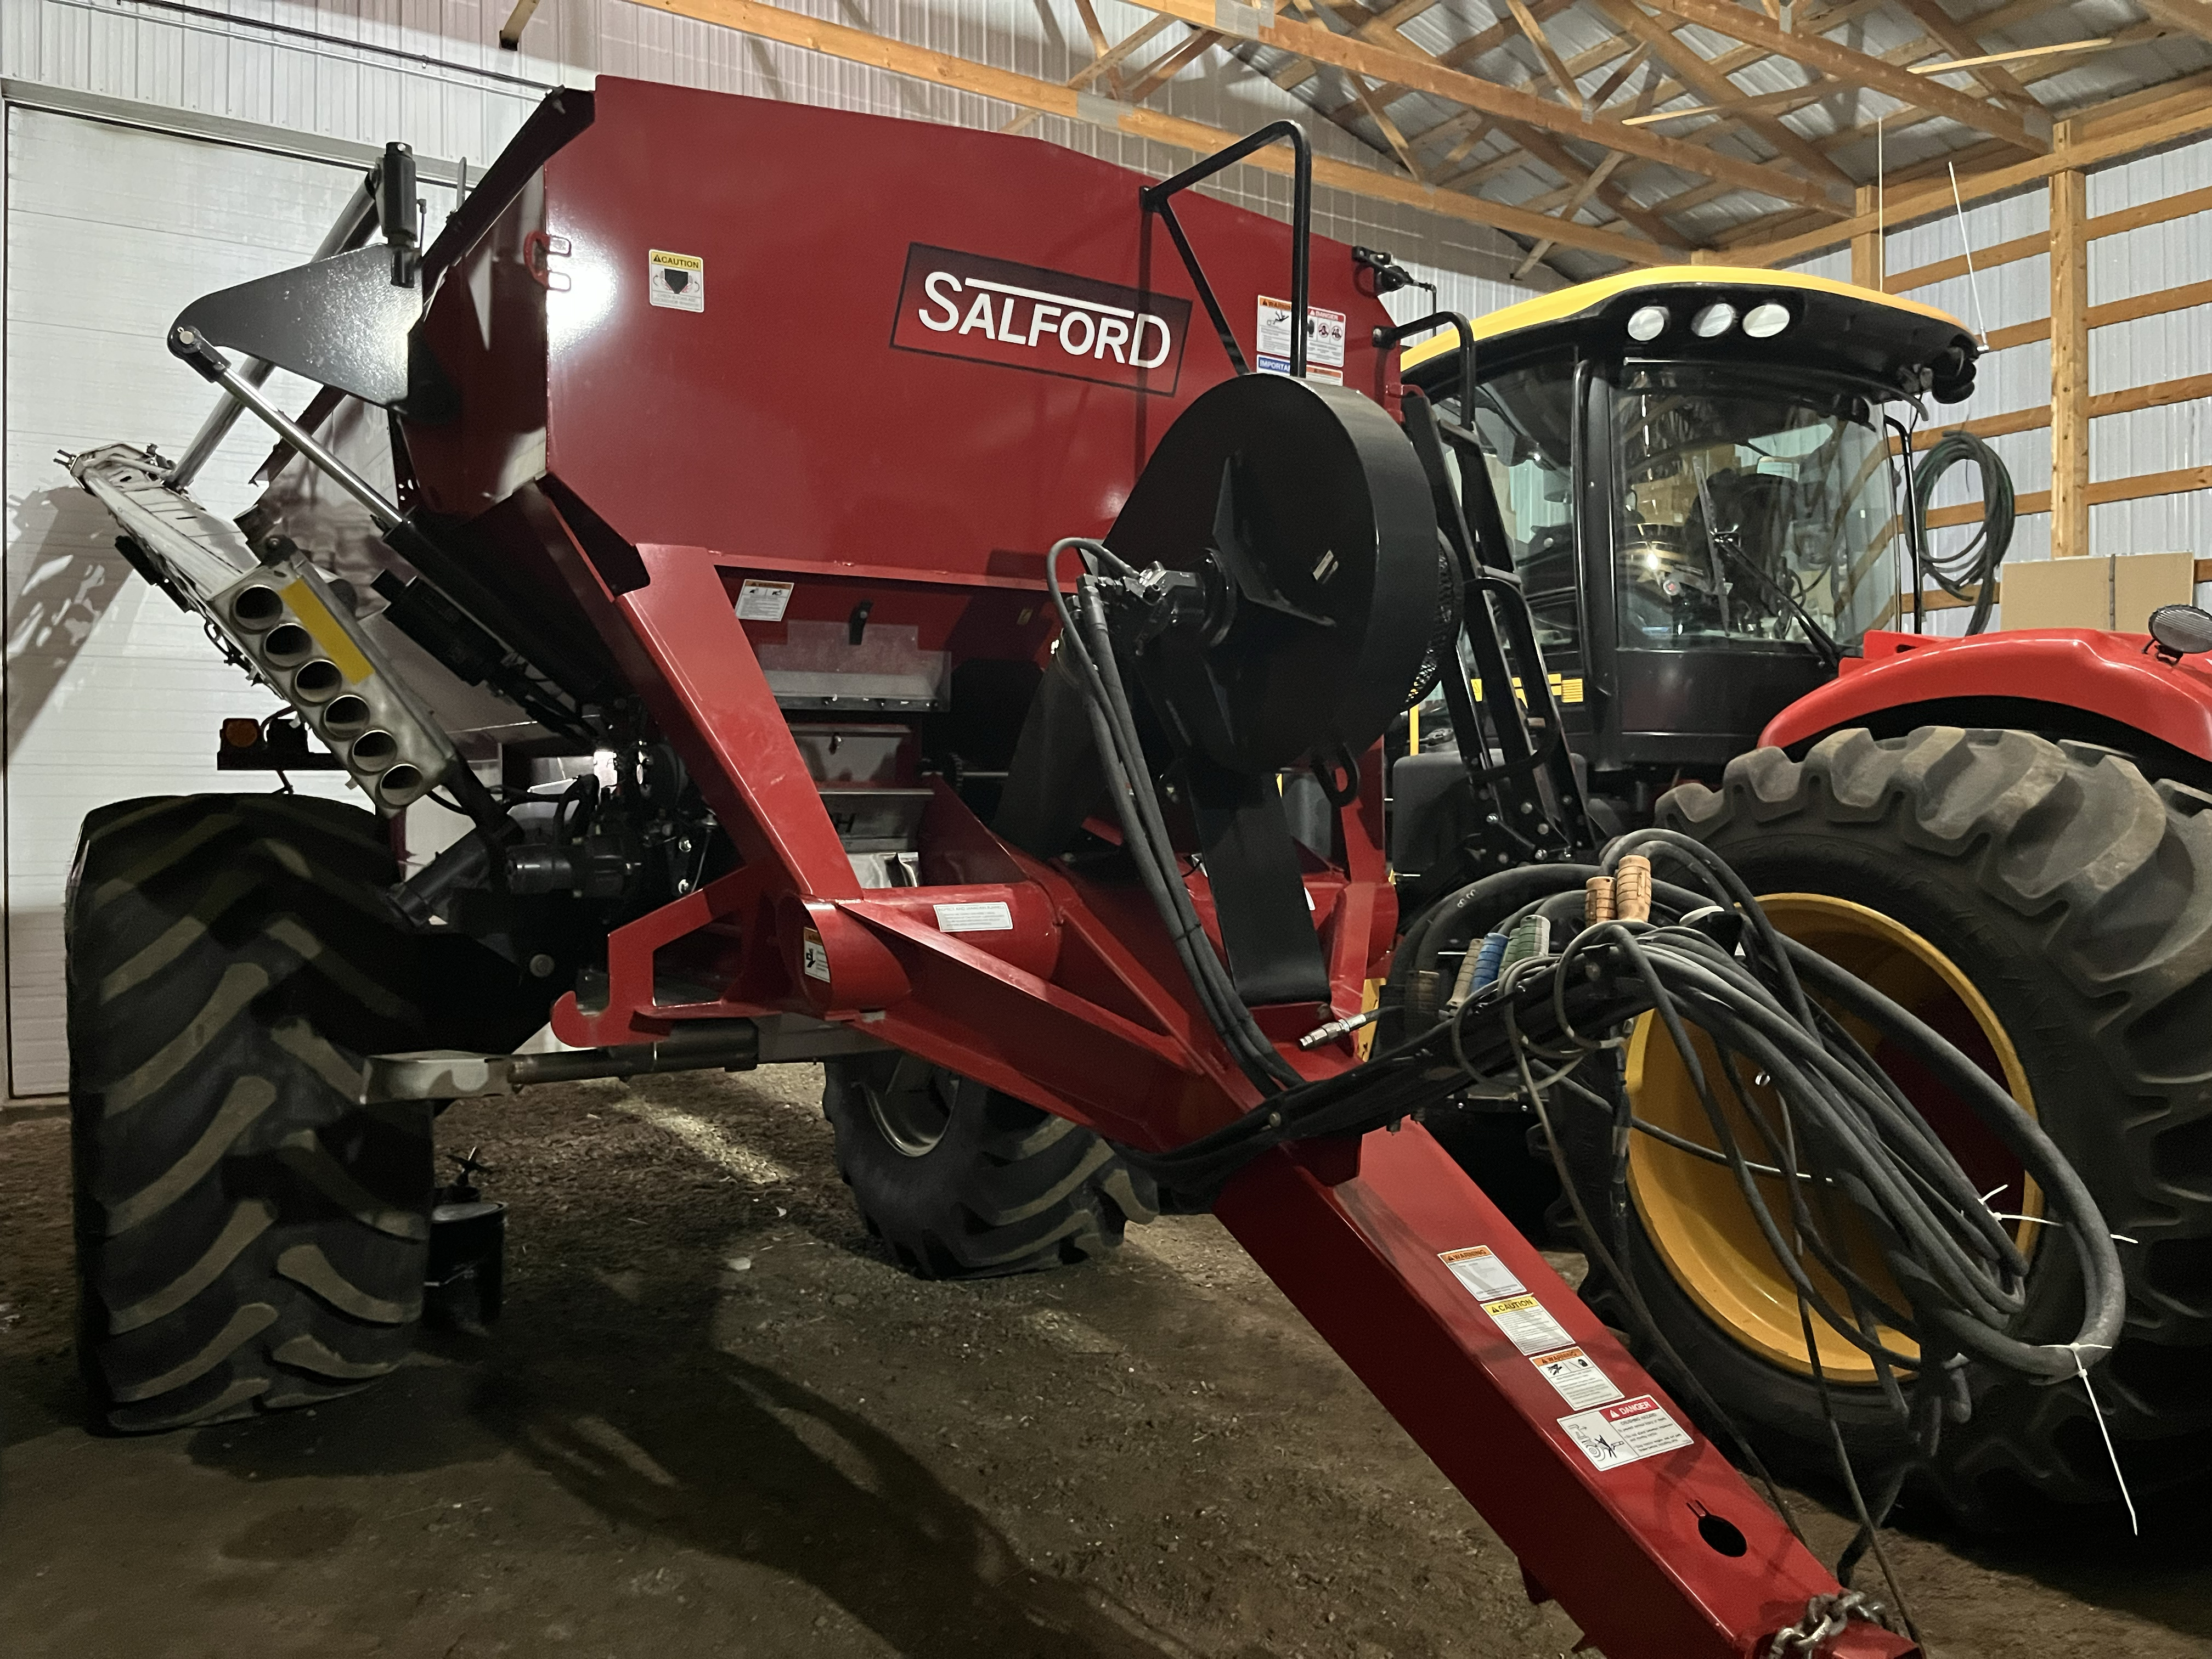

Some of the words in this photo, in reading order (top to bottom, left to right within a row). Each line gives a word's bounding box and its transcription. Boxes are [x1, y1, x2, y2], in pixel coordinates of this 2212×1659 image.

[661, 256, 699, 269] CAUTION
[918, 272, 1171, 369] SALFORD
[1315, 311, 1339, 321] DANGER
[1453, 1249, 1487, 1260] WARNING
[1498, 1299, 1533, 1312] CAUTION
[1547, 1351, 1577, 1362] WARNING
[1619, 1401, 1652, 1415] DANGER
